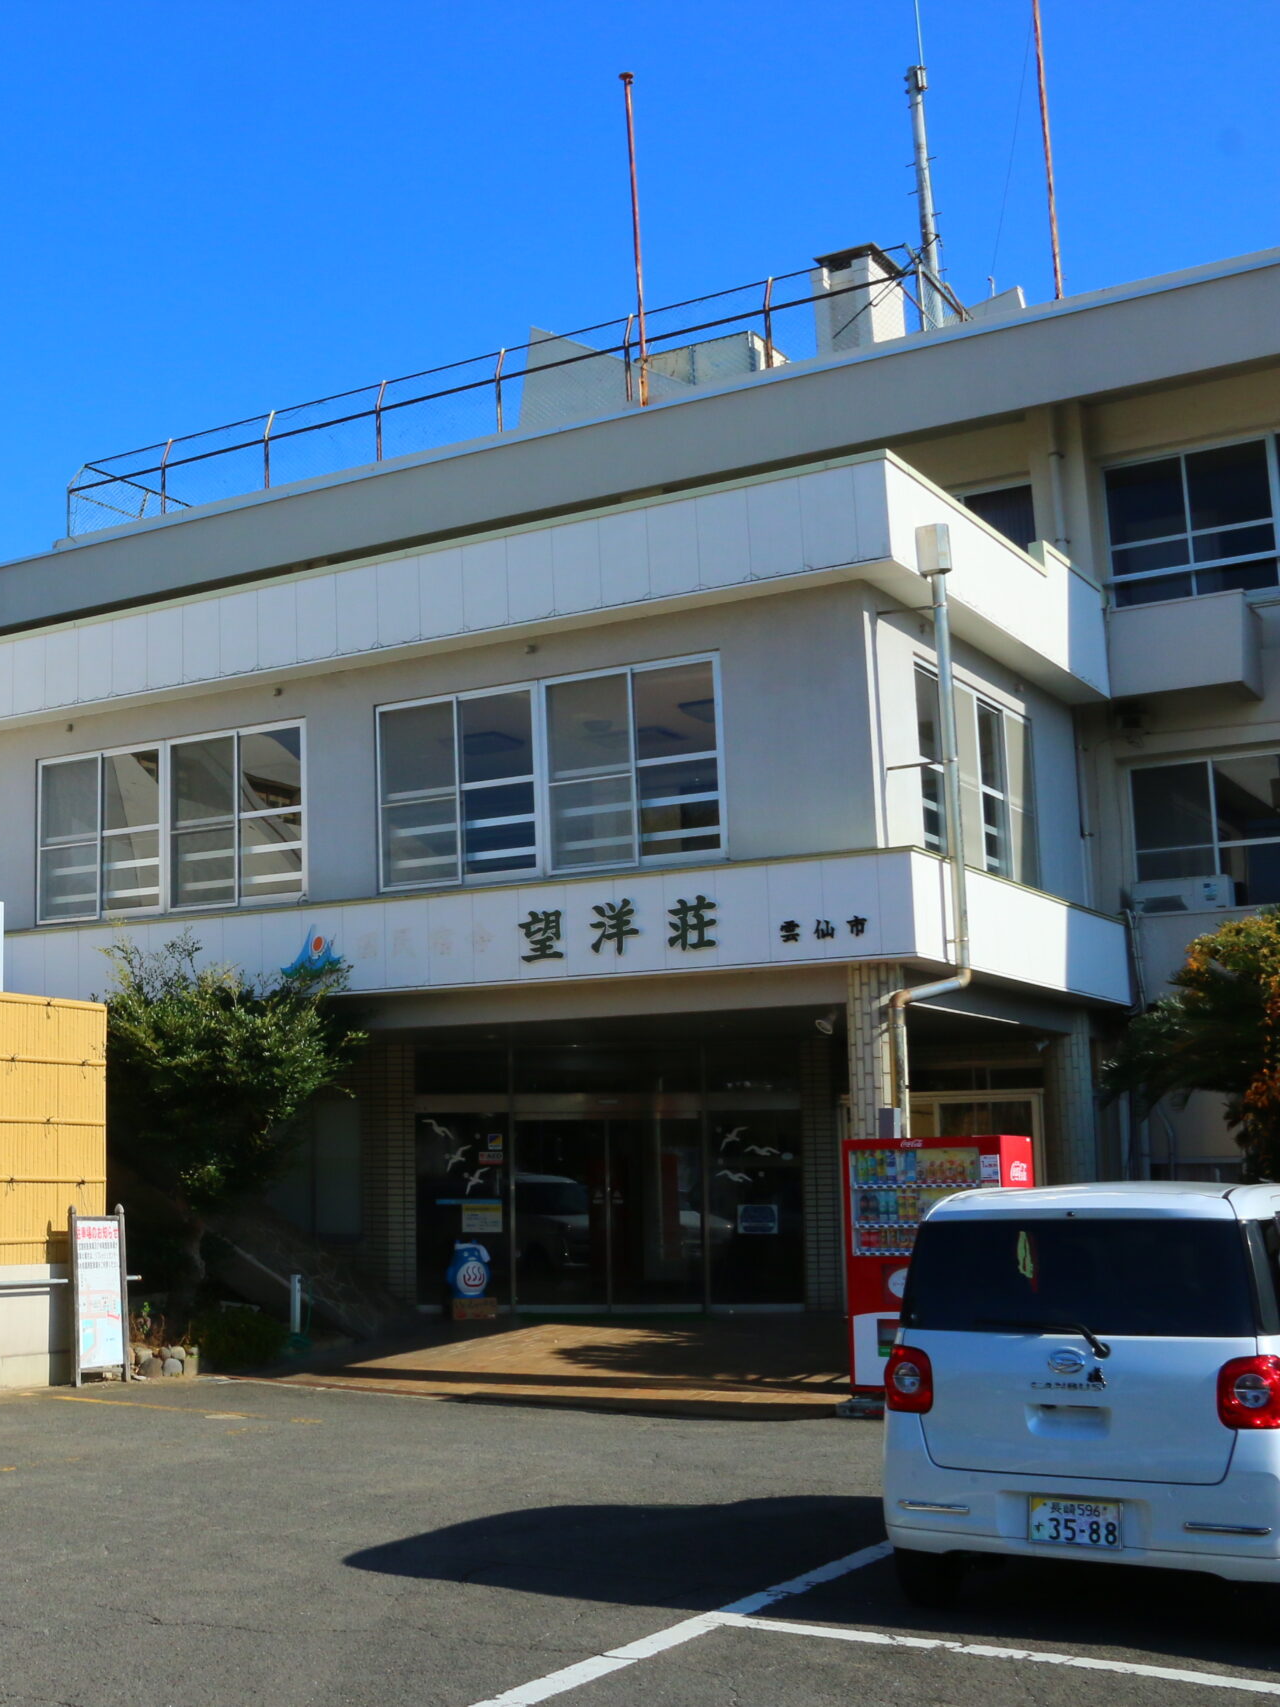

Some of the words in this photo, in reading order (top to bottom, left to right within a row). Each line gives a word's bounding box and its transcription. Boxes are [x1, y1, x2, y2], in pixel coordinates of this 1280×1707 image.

[518, 895, 718, 962] 望洋荘
[780, 915, 868, 943] 雲仙市
[1048, 1517, 1117, 1545] 35-88
